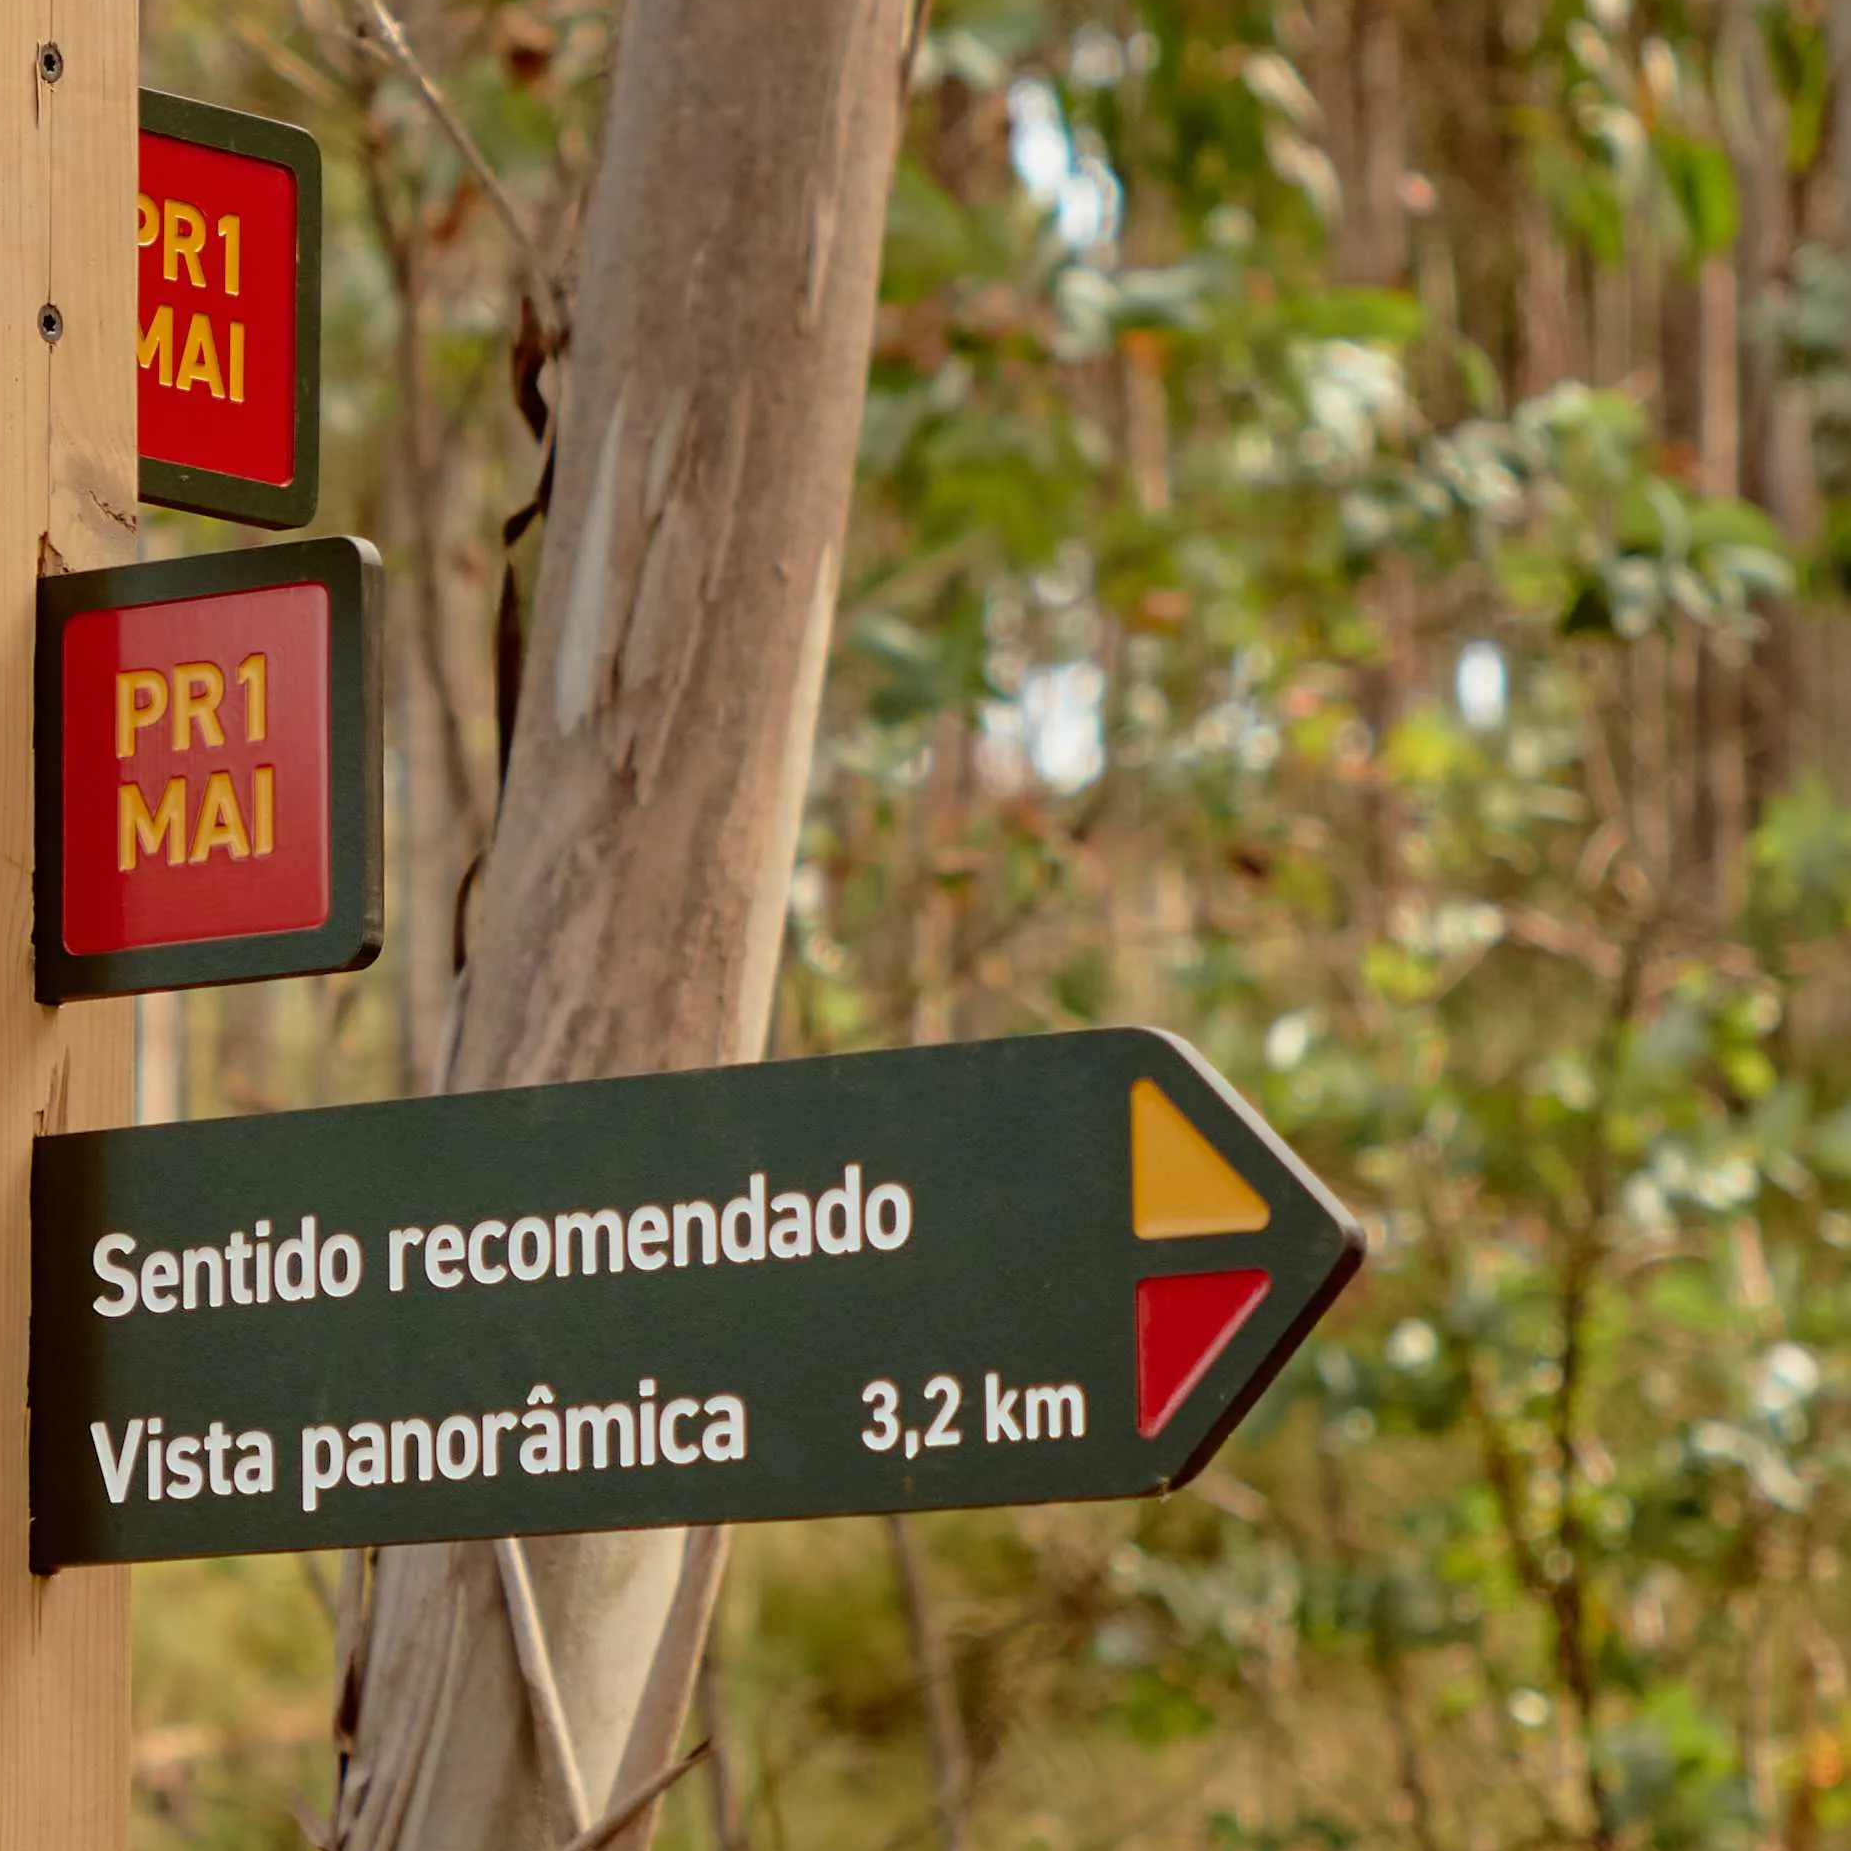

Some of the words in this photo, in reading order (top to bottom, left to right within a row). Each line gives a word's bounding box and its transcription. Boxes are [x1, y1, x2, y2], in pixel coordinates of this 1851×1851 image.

[116, 651, 267, 759] PR1
[118, 766, 275, 872] MAI
[92, 1215, 362, 1318] Sentido
[388, 1164, 912, 1292] recomendado
[90, 1417, 274, 1505] Vista
[301, 1378, 746, 1513] panorâmica
[861, 1375, 961, 1461] 3,2
[984, 1372, 1086, 1443] km
